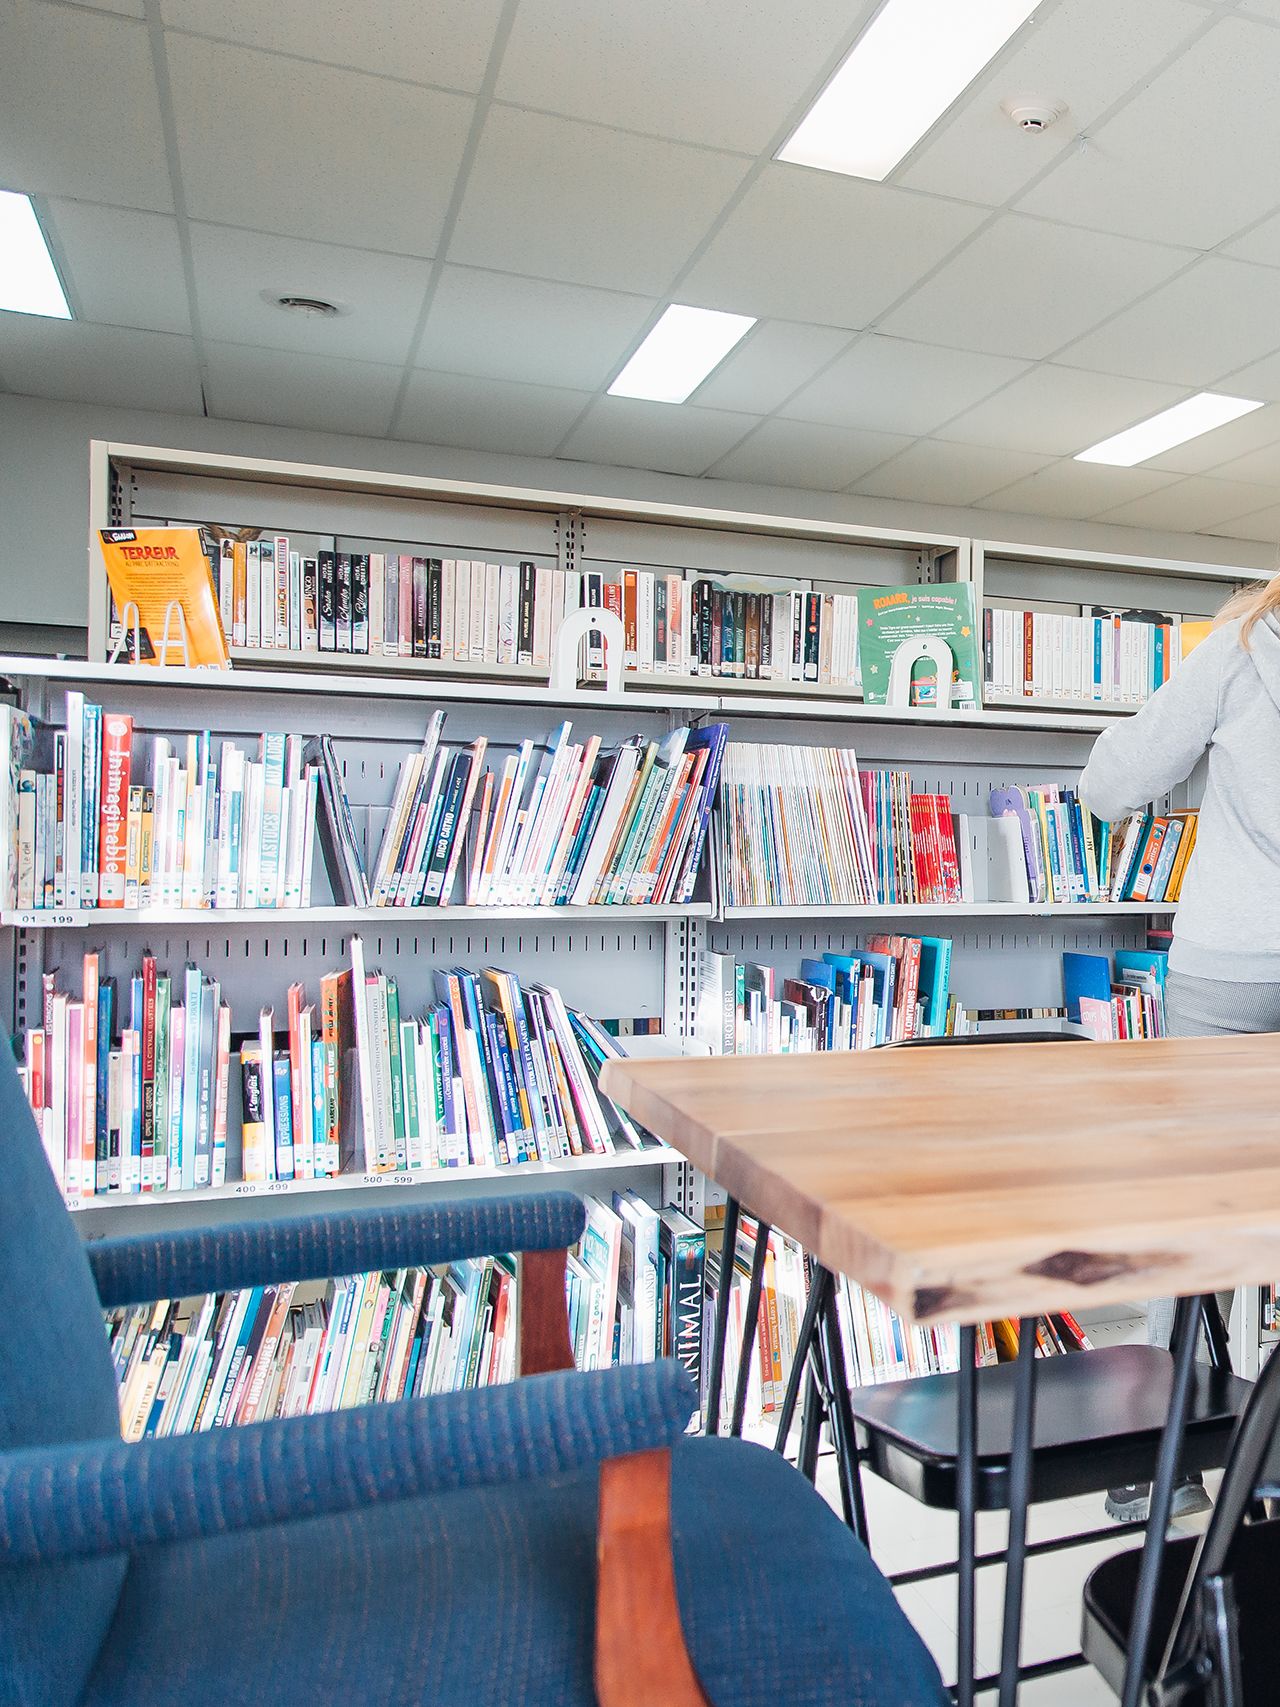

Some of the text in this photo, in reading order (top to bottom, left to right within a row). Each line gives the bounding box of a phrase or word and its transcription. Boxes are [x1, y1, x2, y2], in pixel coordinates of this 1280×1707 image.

[120, 546, 180, 560] TERREUR
[322, 589, 333, 615] Sasha
[266, 734, 282, 760] ADOS
[102, 749, 130, 873] Inimaginable
[260, 812, 278, 857] ASTUCES
[439, 811, 455, 838] CATHO
[435, 838, 449, 858] DICO
[22, 916, 74, 924] 01 199
[906, 990, 916, 1031] LOINTAINS
[248, 1075, 260, 1112] L'anglais
[279, 1094, 290, 1144] EXPRESSIONS
[268, 1183, 288, 1191] 499
[364, 1176, 412, 1184] 500 599
[575, 1333, 585, 1372] animaux
